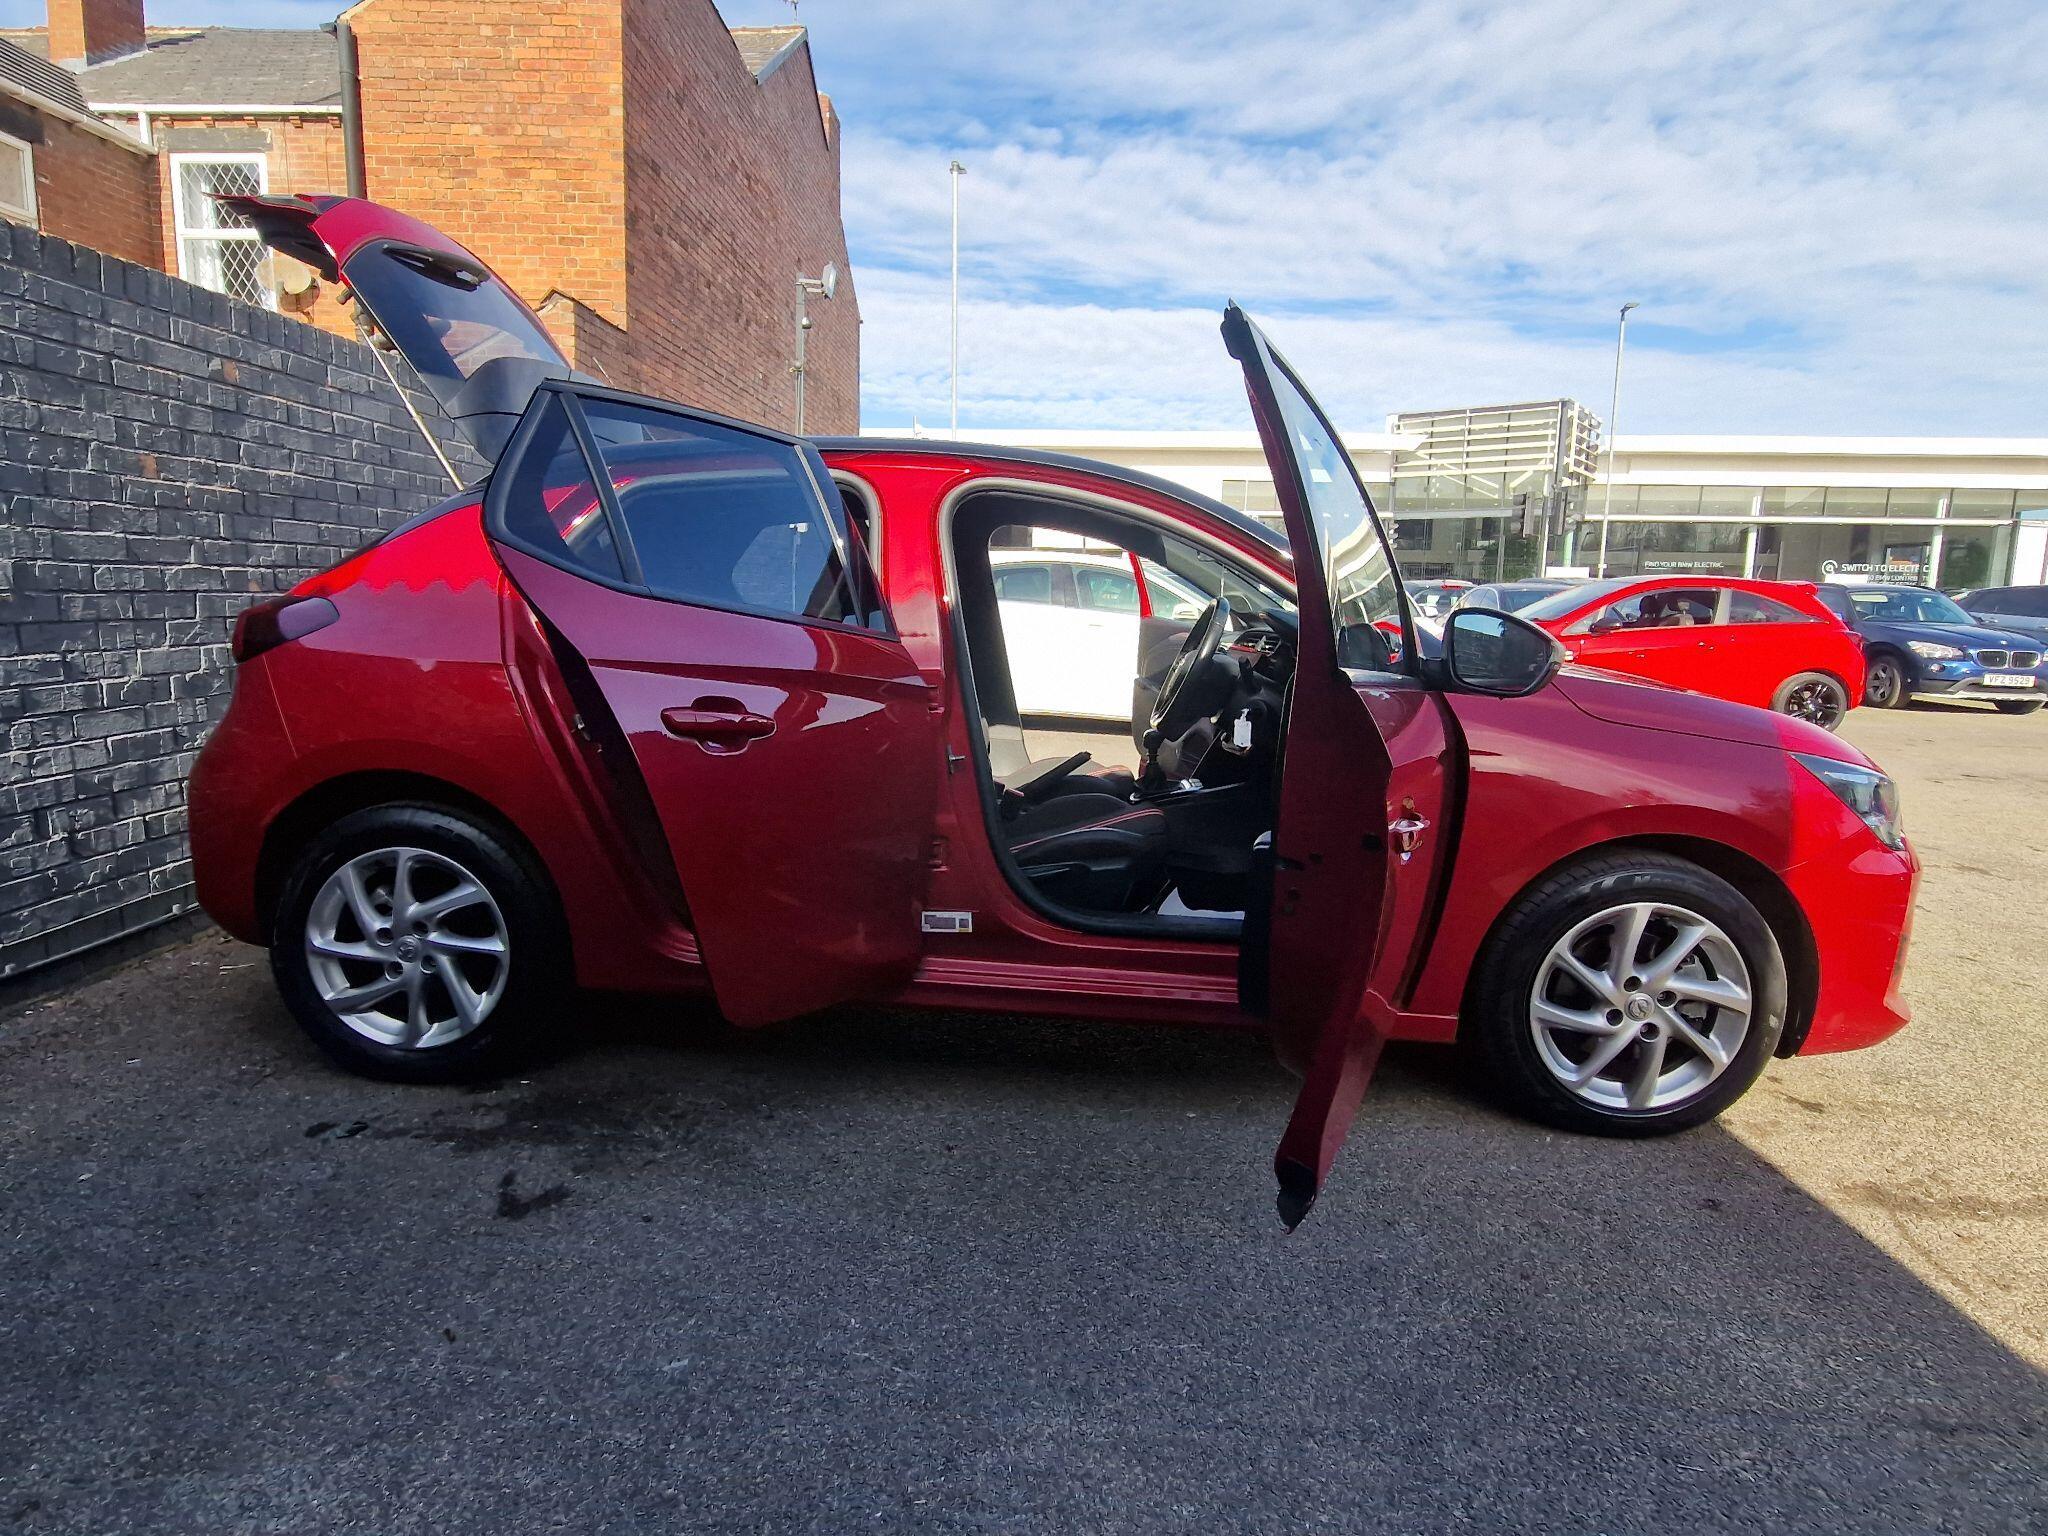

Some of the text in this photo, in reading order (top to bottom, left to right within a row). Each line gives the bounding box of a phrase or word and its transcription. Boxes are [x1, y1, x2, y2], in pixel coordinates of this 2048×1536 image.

[1841, 563, 1873, 572] SWITCH
[1874, 564, 1887, 572] TO
[2008, 676, 2031, 685] 9529
